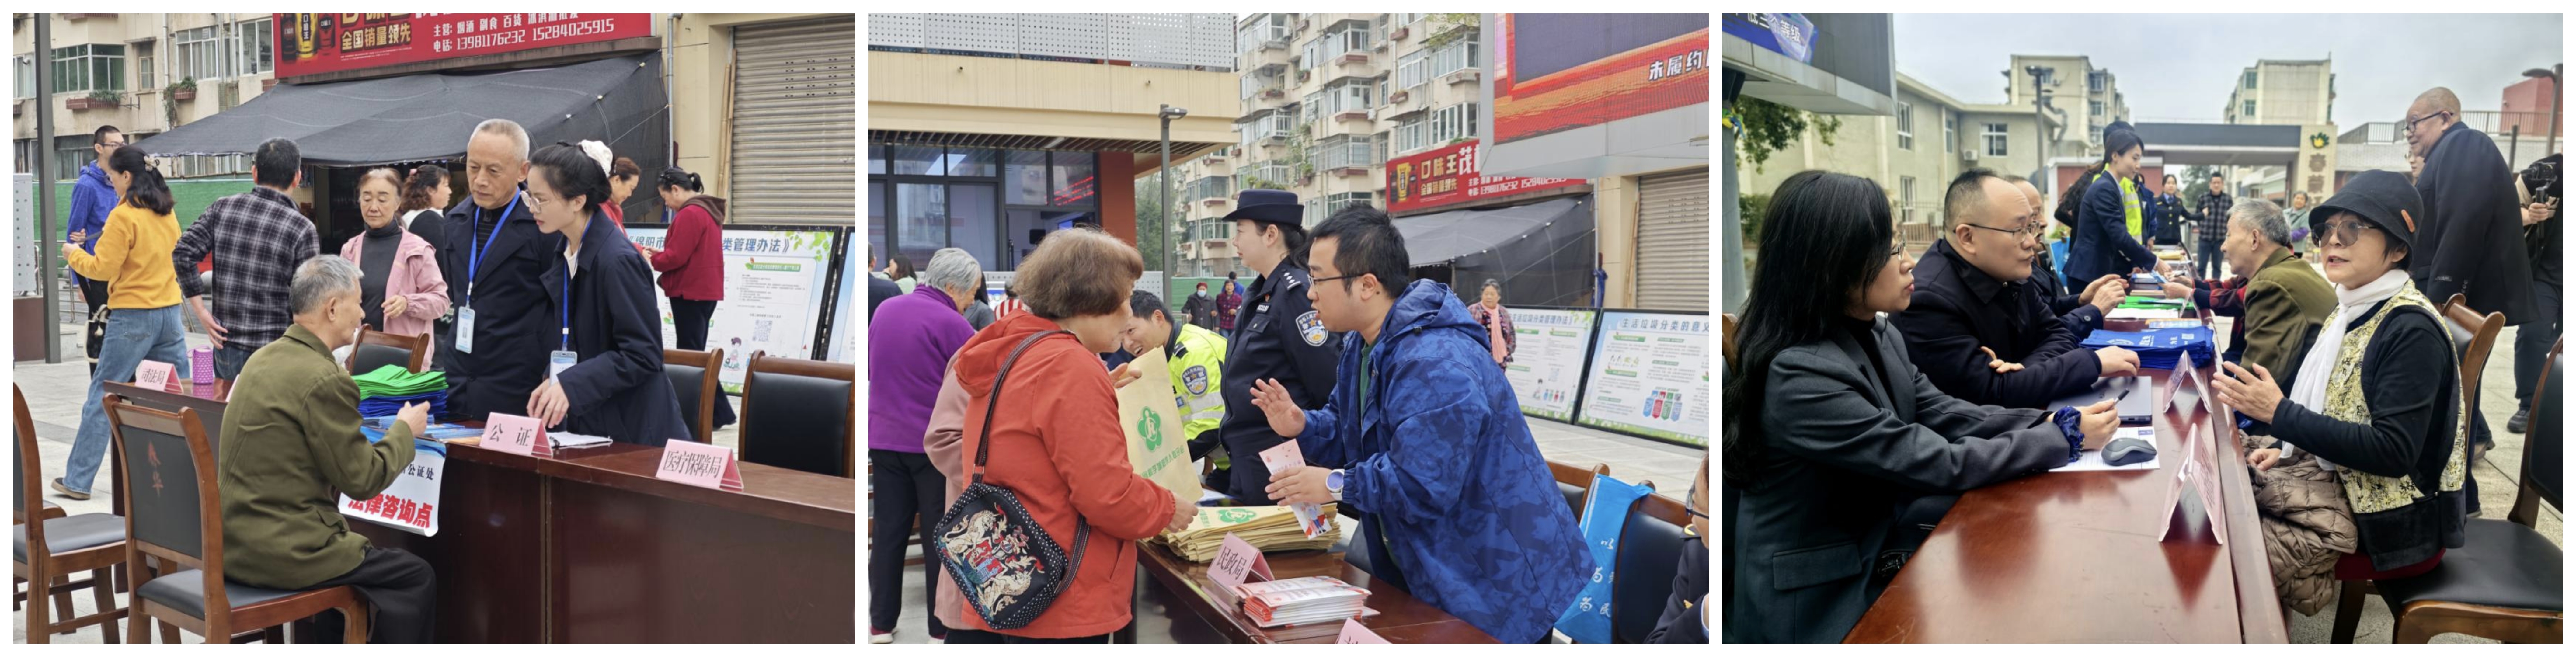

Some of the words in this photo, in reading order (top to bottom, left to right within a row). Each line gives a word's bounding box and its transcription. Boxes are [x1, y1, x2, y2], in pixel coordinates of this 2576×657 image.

[342, 23, 411, 50] 全国销量领先
[457, 20, 474, 34] 烟酒
[479, 17, 497, 31] 副食
[503, 14, 522, 28] 百货
[457, 30, 525, 50] 13981176232
[533, 18, 614, 41] 15284025915
[1735, 13, 1801, 43] 低三个等级
[1649, 49, 1709, 80] 未履约
[141, 368, 166, 384] 司法局
[402, 464, 434, 480] 公证处
[663, 450, 722, 478] 医疗保障局
[1217, 546, 1247, 580] 民政局
